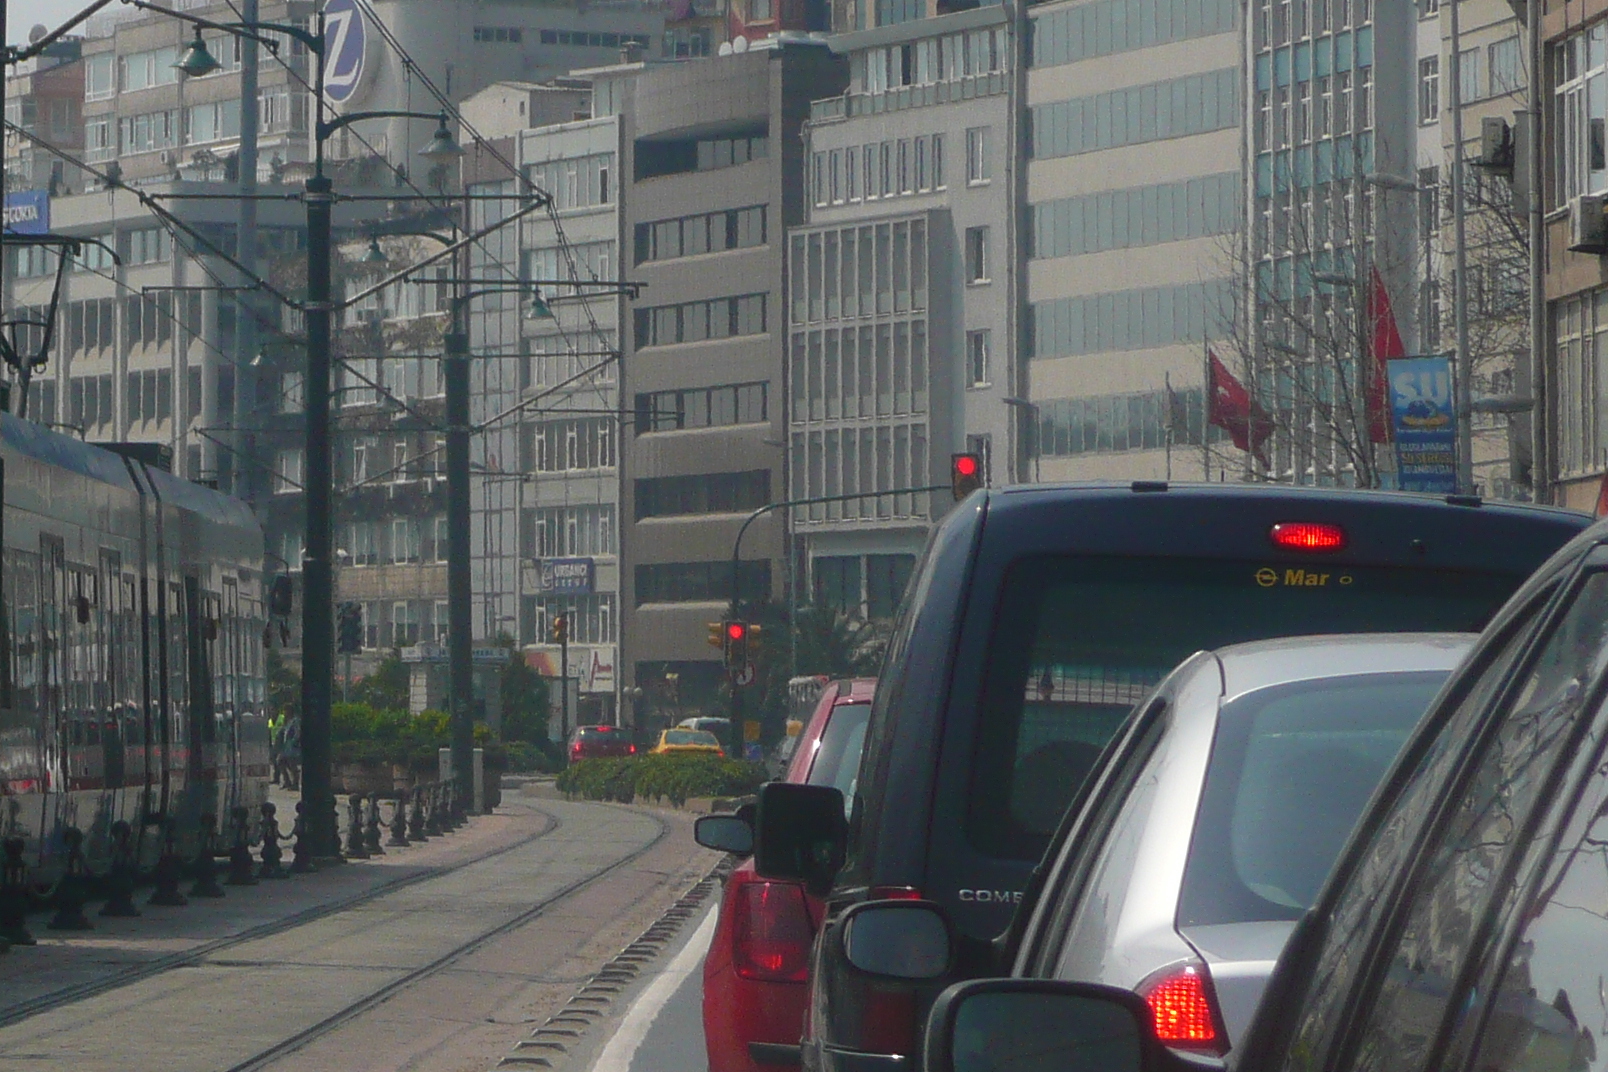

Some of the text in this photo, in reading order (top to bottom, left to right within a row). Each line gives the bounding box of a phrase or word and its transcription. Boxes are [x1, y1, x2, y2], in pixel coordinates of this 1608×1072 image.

[324, 9, 360, 87] Z
[1393, 370, 1449, 409] SU
[1283, 568, 1330, 586] Mar
